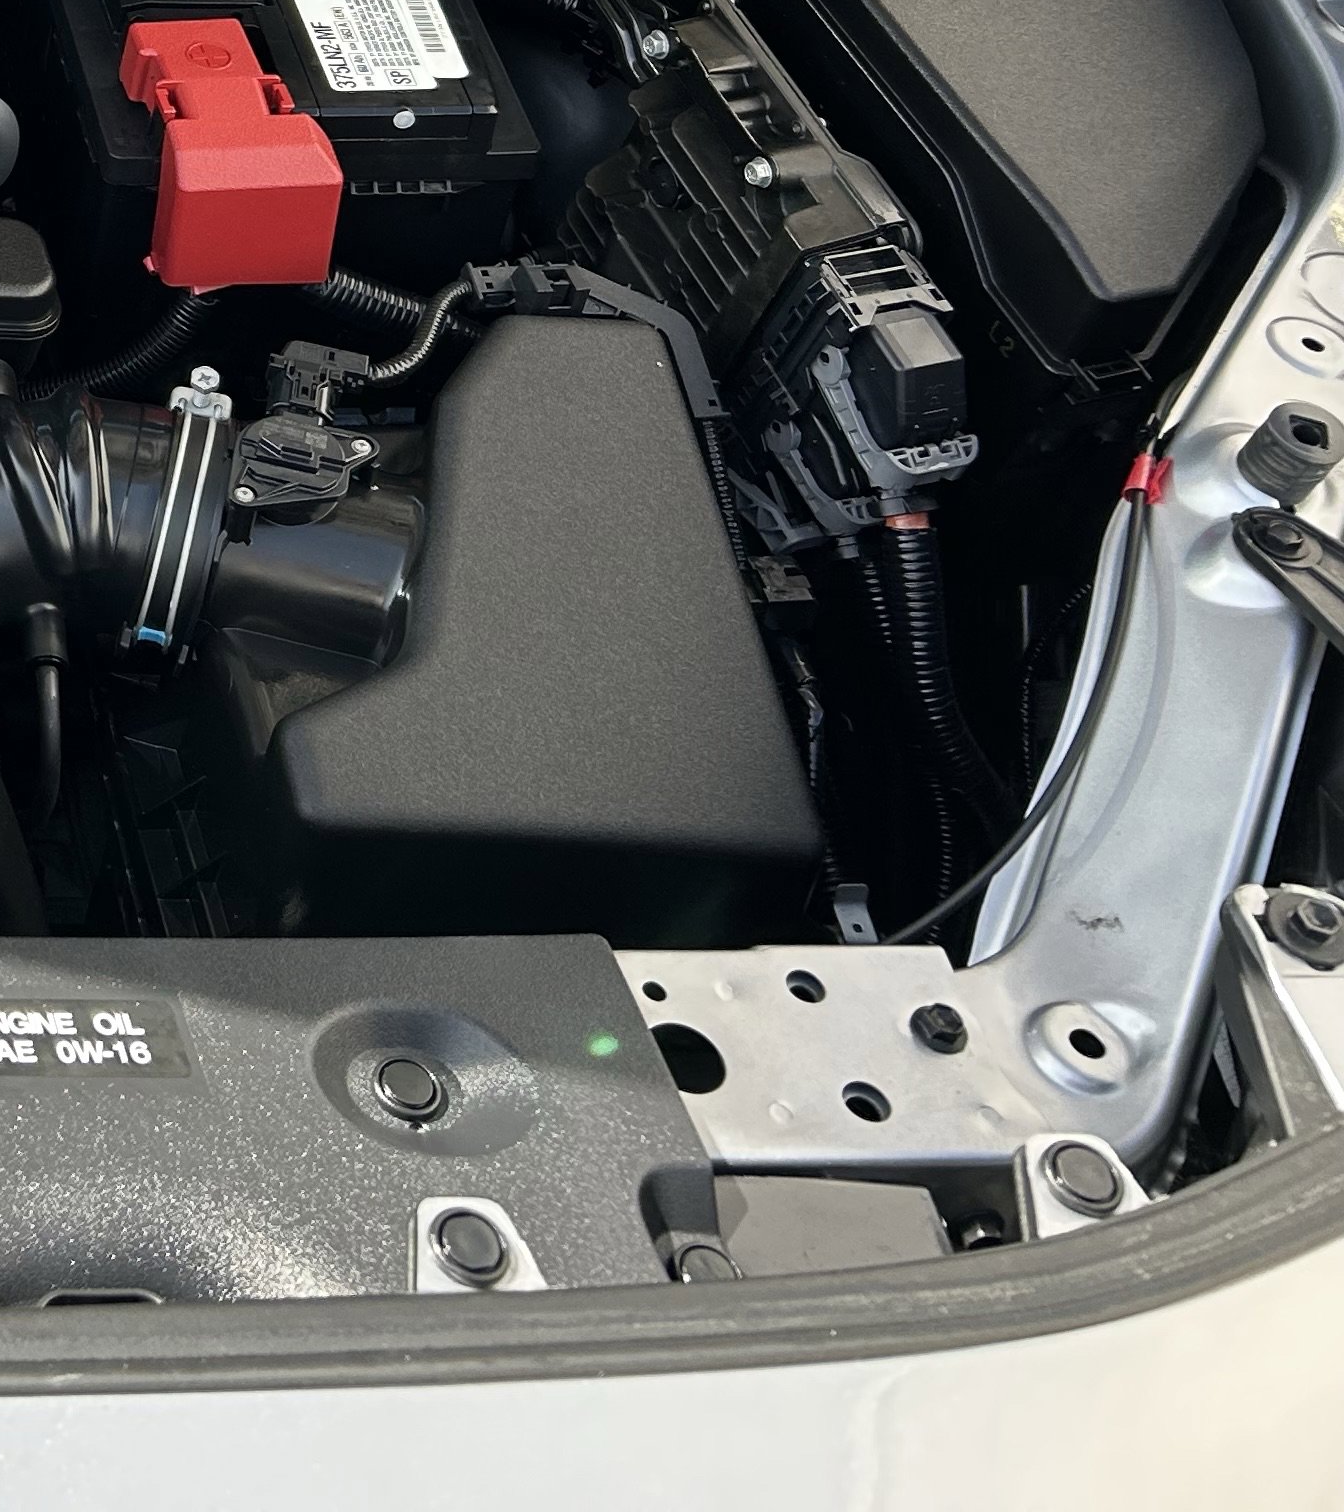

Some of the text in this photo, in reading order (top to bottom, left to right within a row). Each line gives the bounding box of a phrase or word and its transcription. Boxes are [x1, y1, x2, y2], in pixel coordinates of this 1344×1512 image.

[310, 21, 357, 89] 375LN2-MF
[390, 70, 412, 85] SP
[92, 1011, 146, 1036] OIL
[55, 1039, 152, 1065] 0W-16
